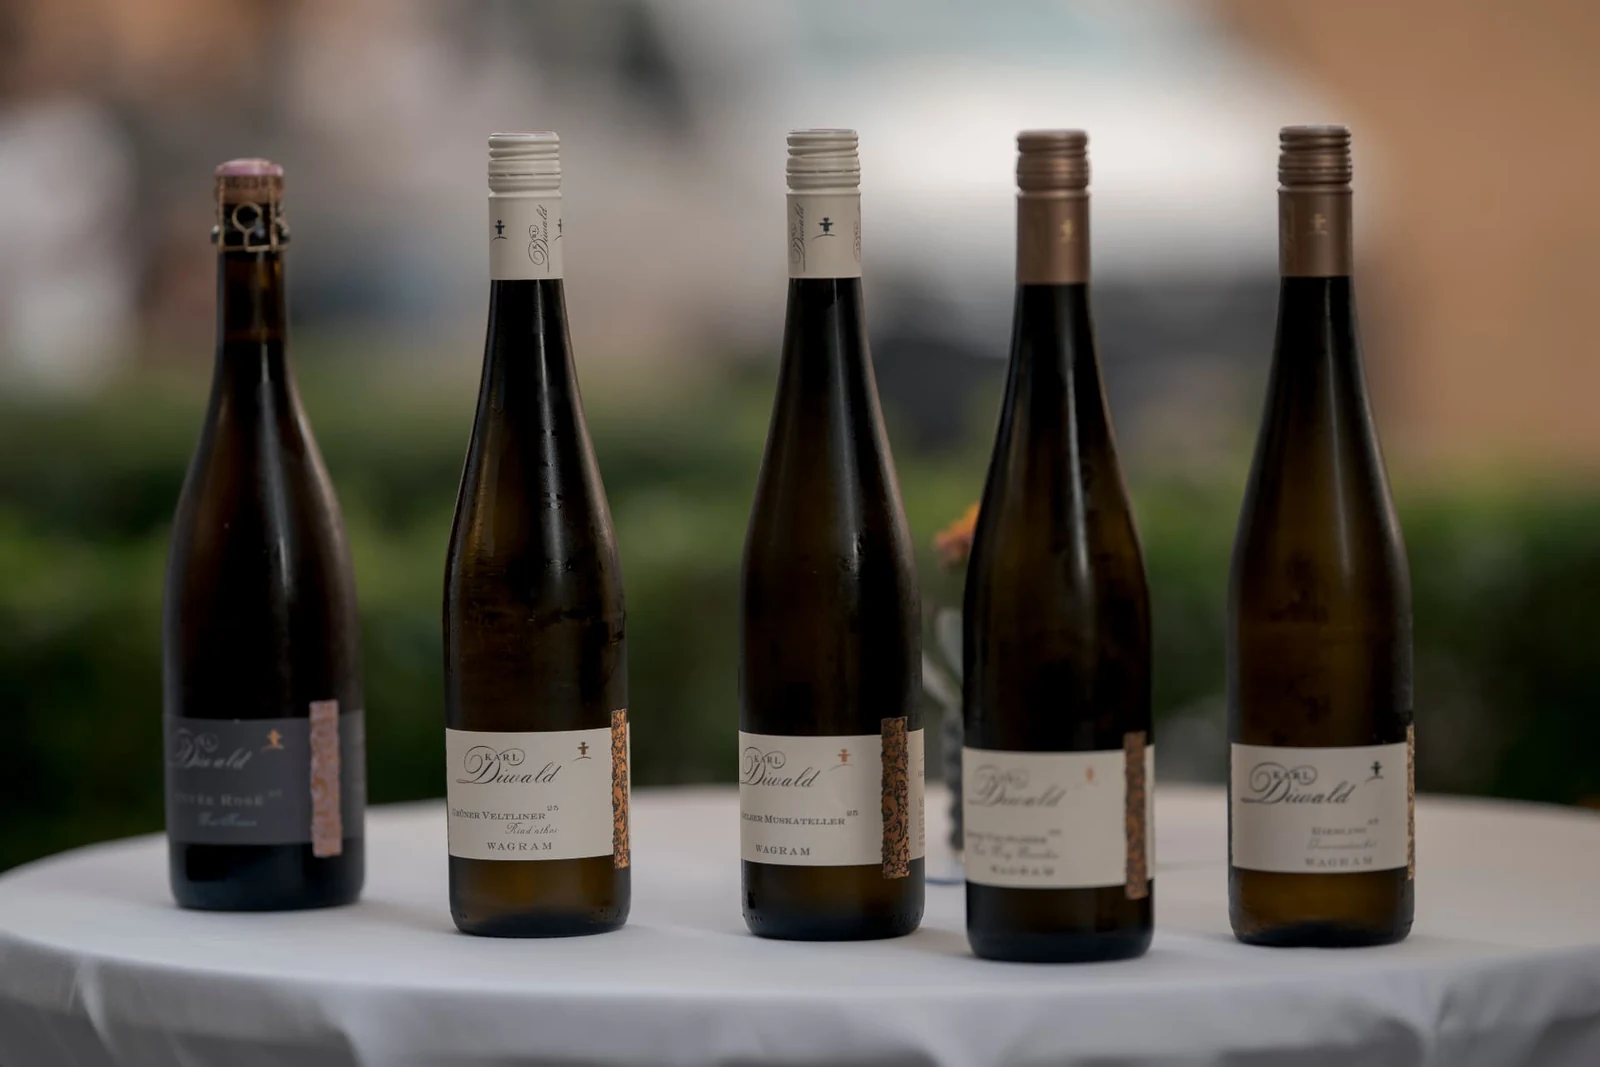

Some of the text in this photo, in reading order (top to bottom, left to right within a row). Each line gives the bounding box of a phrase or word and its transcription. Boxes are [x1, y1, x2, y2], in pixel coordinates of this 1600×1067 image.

[527, 204, 550, 273] Diwald
[484, 753, 520, 762] KARL
[456, 745, 562, 785] Diwald
[740, 746, 821, 788] Diwald
[1240, 761, 1357, 805] Diwald
[482, 811, 546, 821] VELTLINER
[764, 814, 846, 826] MUSKATELLER
[486, 842, 553, 851] WAGRAM
[755, 843, 811, 856] WAGRAM
